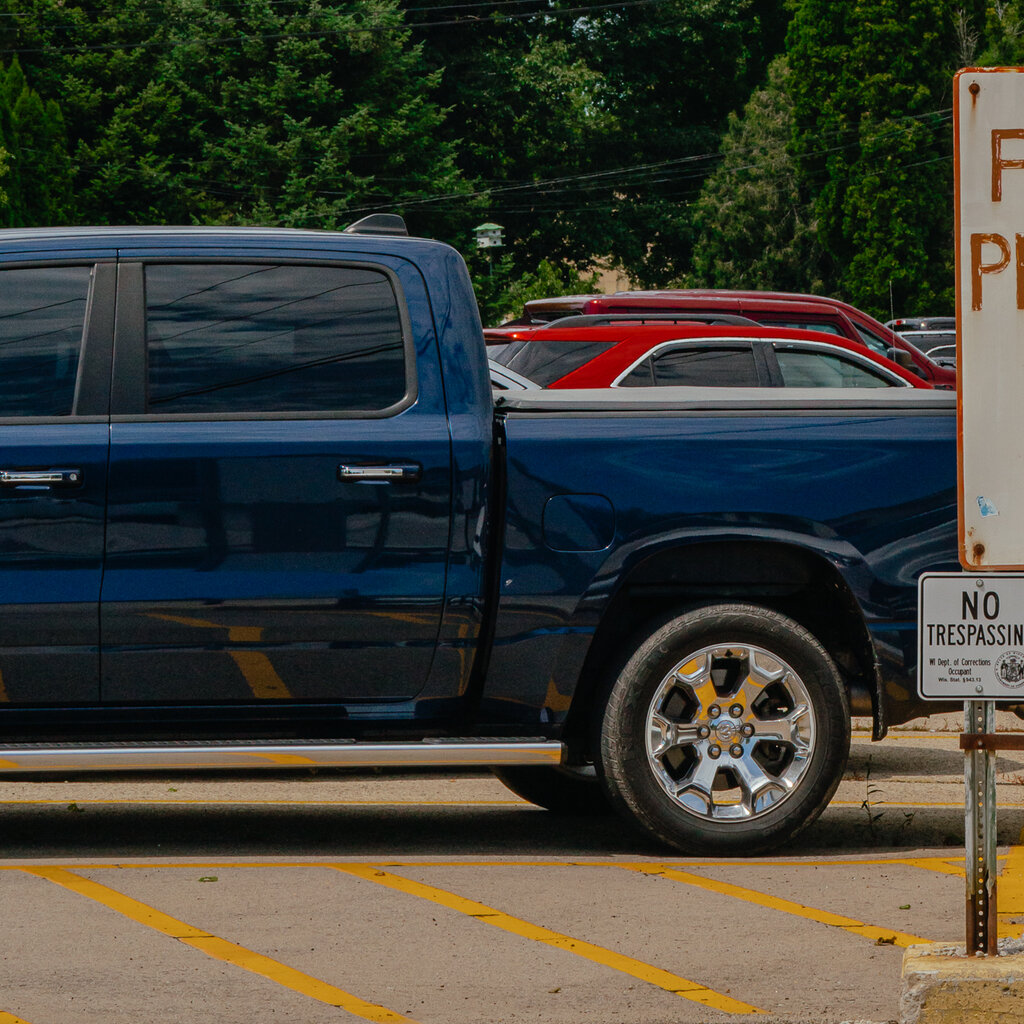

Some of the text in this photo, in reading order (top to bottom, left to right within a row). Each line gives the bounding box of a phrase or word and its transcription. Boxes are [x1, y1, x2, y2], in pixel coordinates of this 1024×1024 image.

[961, 590, 1000, 621] NO
[929, 658, 991, 667] WI Dept. of Corrections
[948, 667, 972, 677] Occupant
